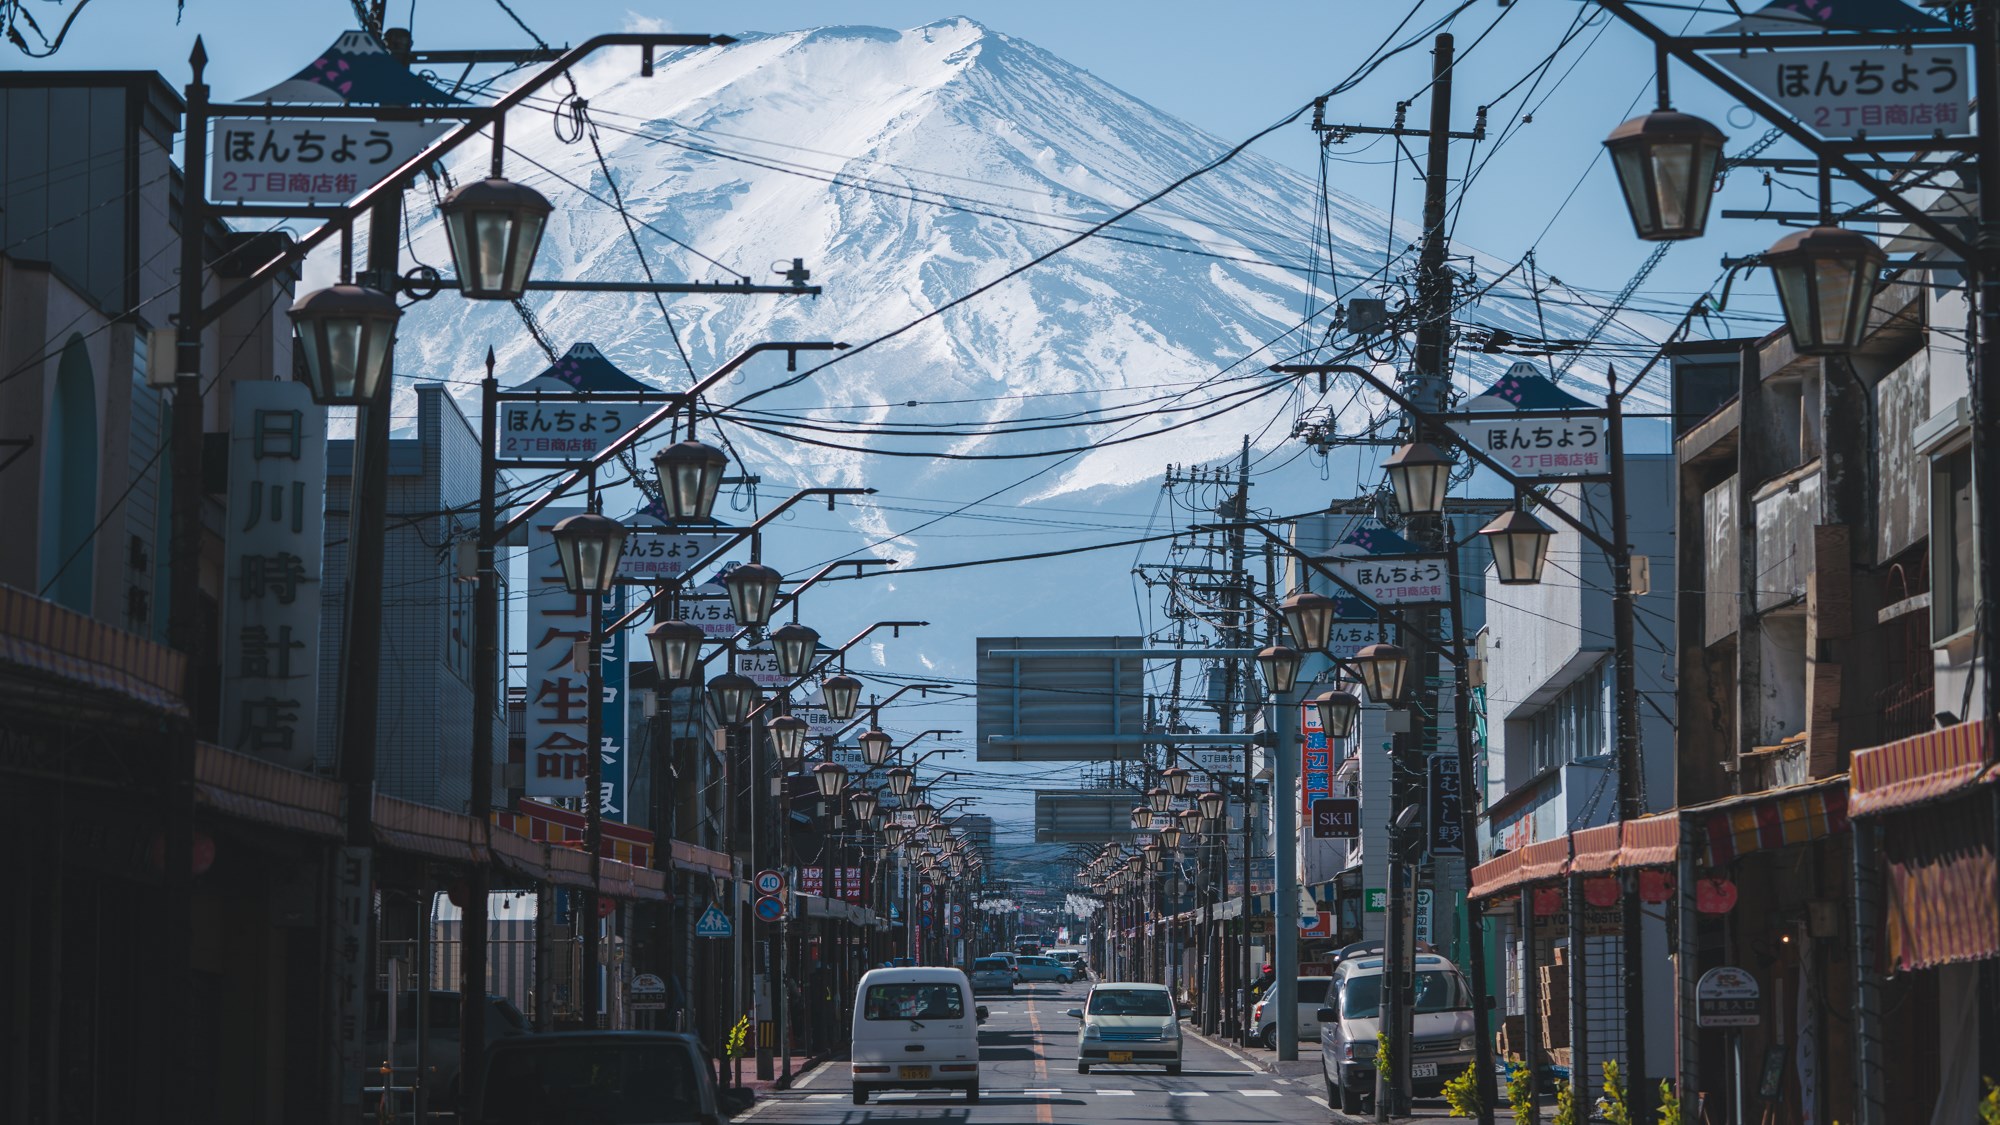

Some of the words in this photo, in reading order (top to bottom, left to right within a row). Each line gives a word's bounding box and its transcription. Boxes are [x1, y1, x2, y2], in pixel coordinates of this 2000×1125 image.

[1778, 57, 1957, 98] ほんちょう
[1814, 103, 1958, 127] 2丁目商店街
[224, 129, 393, 164] ほんちょう
[222, 172, 357, 194] 2丁目商店街
[507, 409, 622, 434] ほんちょう
[507, 437, 597, 453] 2丁目商店街
[1488, 425, 1597, 450] ほんちょう
[1512, 452, 1598, 468] 2丁目商店街
[617, 561, 681, 573] 丁目商店街
[1357, 564, 1441, 585] ほんちょう
[236, 408, 306, 752] 日川時計店
[1375, 585, 1441, 599] 2丁目商店街
[680, 605, 735, 620] ほんちょ
[534, 525, 588, 780] コク生命
[751, 674, 791, 682] 丁目商店街
[762, 877, 778, 889] 40
